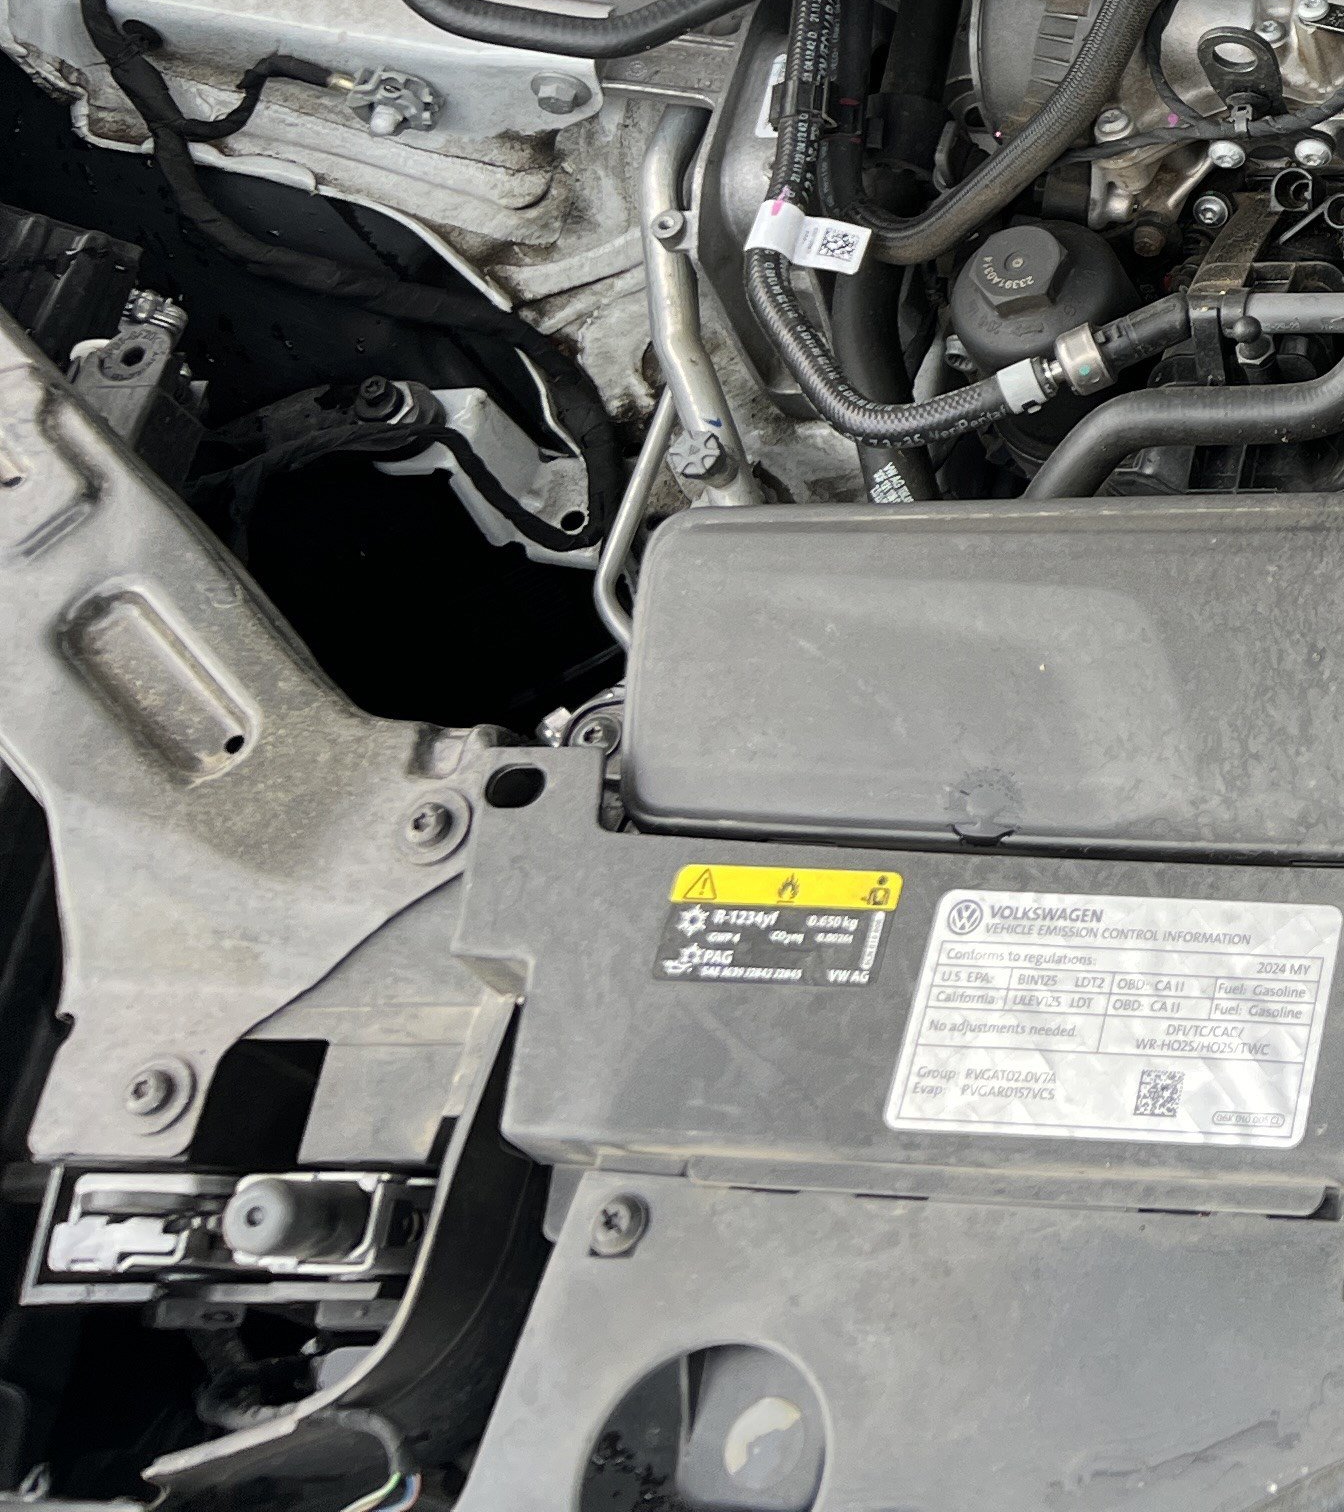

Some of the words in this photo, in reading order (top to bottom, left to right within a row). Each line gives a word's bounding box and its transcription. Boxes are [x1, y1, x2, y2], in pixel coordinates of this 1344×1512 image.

[709, 908, 779, 928] R-1234yf
[840, 915, 860, 931] kg
[987, 904, 1105, 924] VOLKSWAGEN
[983, 922, 1035, 936] VEHICLE
[1036, 924, 1099, 938] EMISSION
[1100, 927, 1160, 941] CONTROL
[1161, 929, 1249, 945] INFORMATION
[701, 949, 734, 964] PAG
[945, 947, 1006, 962] Conforms
[1006, 950, 1022, 962] to
[1255, 962, 1287, 974] 2024
[1288, 963, 1311, 975] MY
[823, 969, 850, 982] VW
[849, 970, 871, 983] AG
[1073, 975, 1106, 989] LDT2
[1153, 979, 1173, 992] CA
[1251, 983, 1307, 998] Gasoline
[1069, 996, 1094, 1009] LDT
[1149, 999, 1169, 1012] CA
[1247, 1004, 1303, 1019] Gasoline
[927, 1017, 948, 1031] No
[947, 1018, 1027, 1038] adjustments
